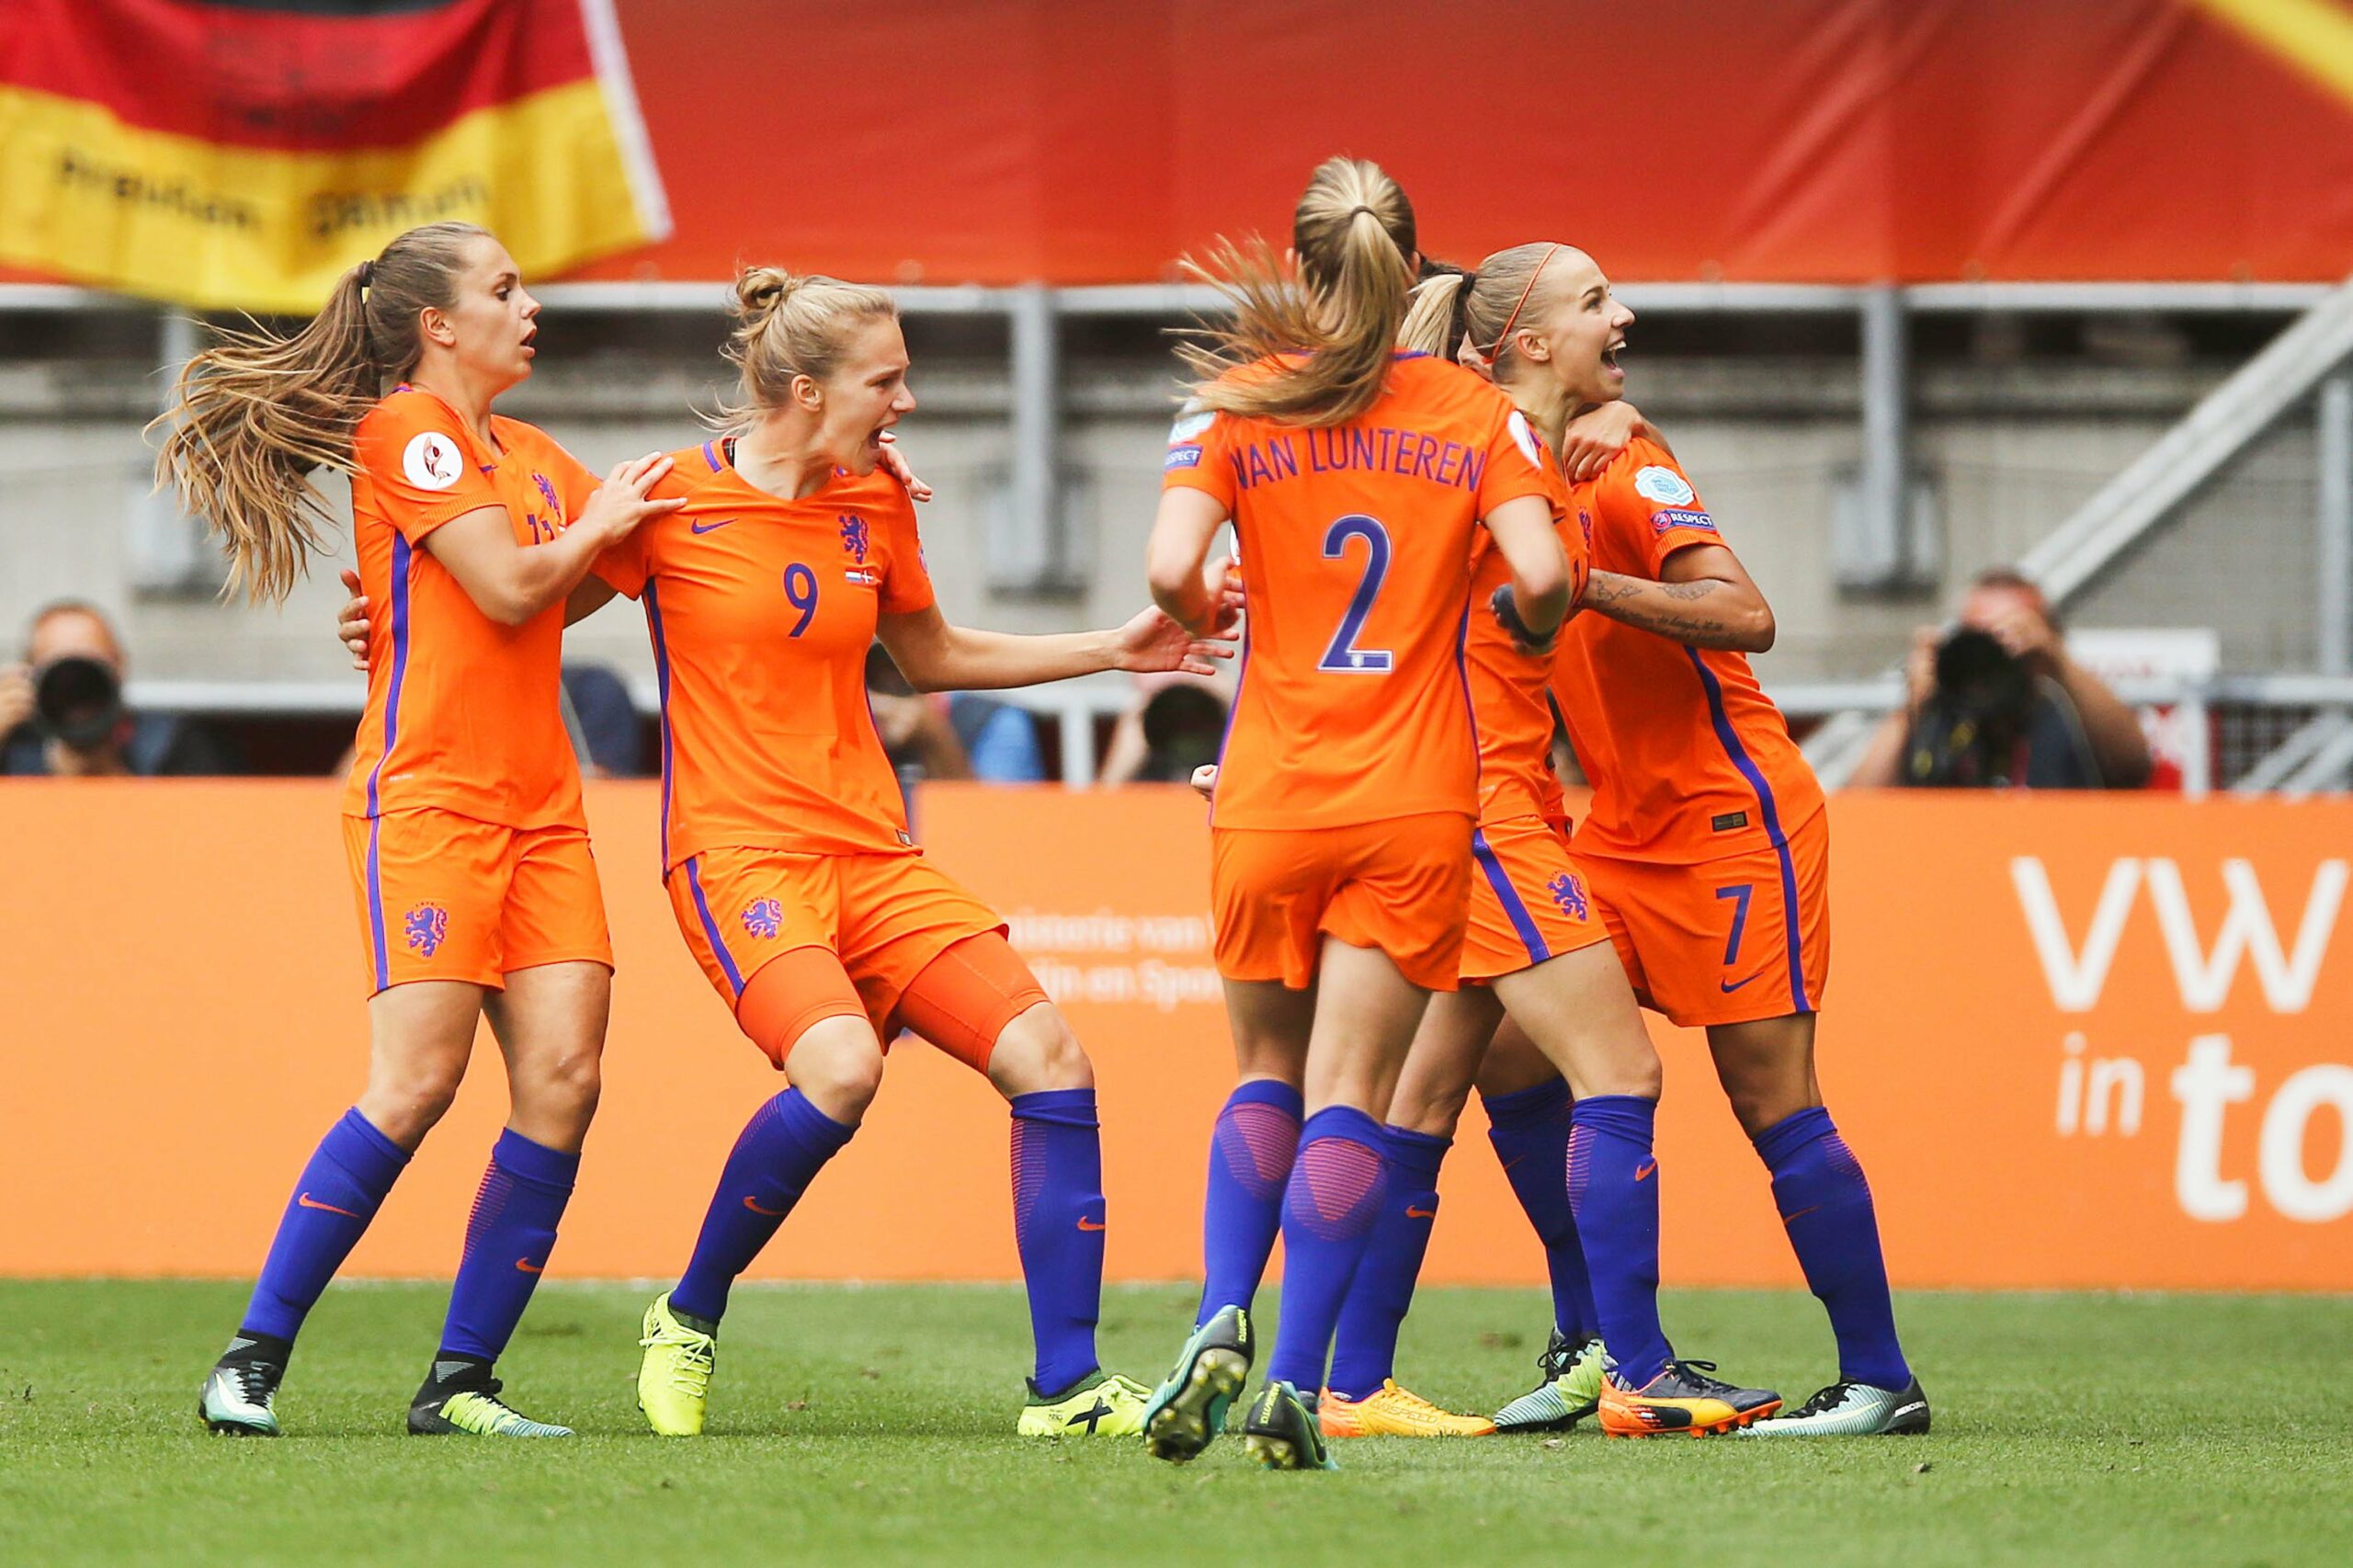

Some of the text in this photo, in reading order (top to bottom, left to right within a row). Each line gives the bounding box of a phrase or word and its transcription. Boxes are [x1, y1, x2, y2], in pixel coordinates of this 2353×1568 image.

[1230, 426, 1486, 493] VAN LUNTEREN
[1669, 513, 1712, 527] RESPECT
[783, 562, 819, 638] 9
[1317, 515, 1394, 673] 2
[1715, 884, 1754, 965] 7
[2055, 1030, 2145, 1138] in
